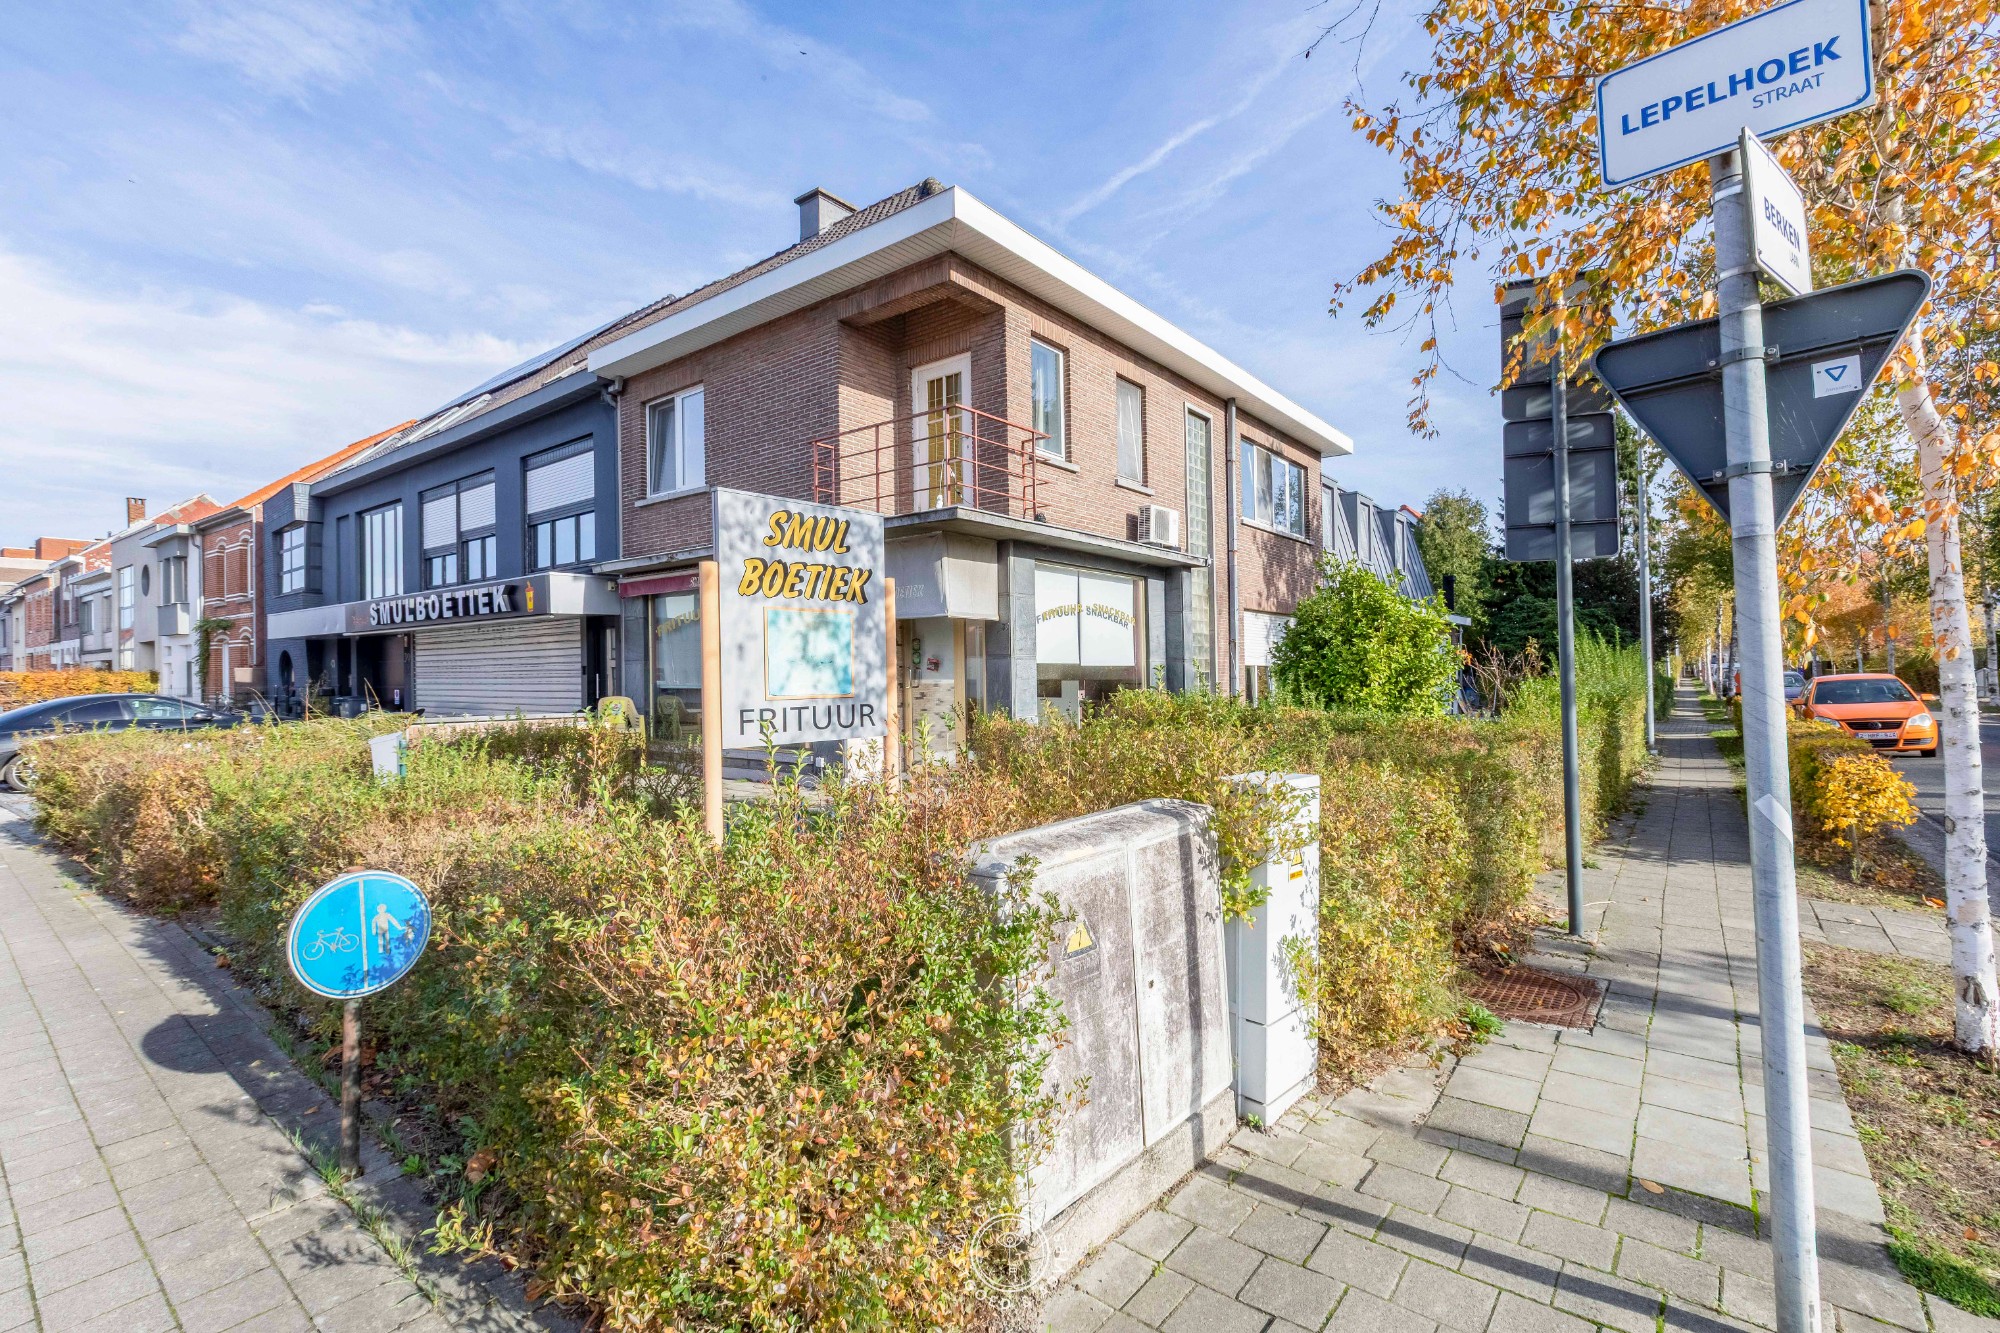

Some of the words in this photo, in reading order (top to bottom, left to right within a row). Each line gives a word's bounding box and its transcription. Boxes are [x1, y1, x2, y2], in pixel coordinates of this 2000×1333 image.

[1621, 35, 1842, 136] LEPELHOEK
[1752, 72, 1825, 110] STRAAT
[1764, 196, 1800, 252] BERKEN
[763, 509, 850, 554] SMUL
[738, 557, 872, 605] BOETIEK
[369, 585, 512, 626] SMULBOETIEK
[656, 607, 701, 638] FRITUU
[1092, 603, 1137, 627] SNACKBAR
[739, 703, 876, 736] FRITUUR
